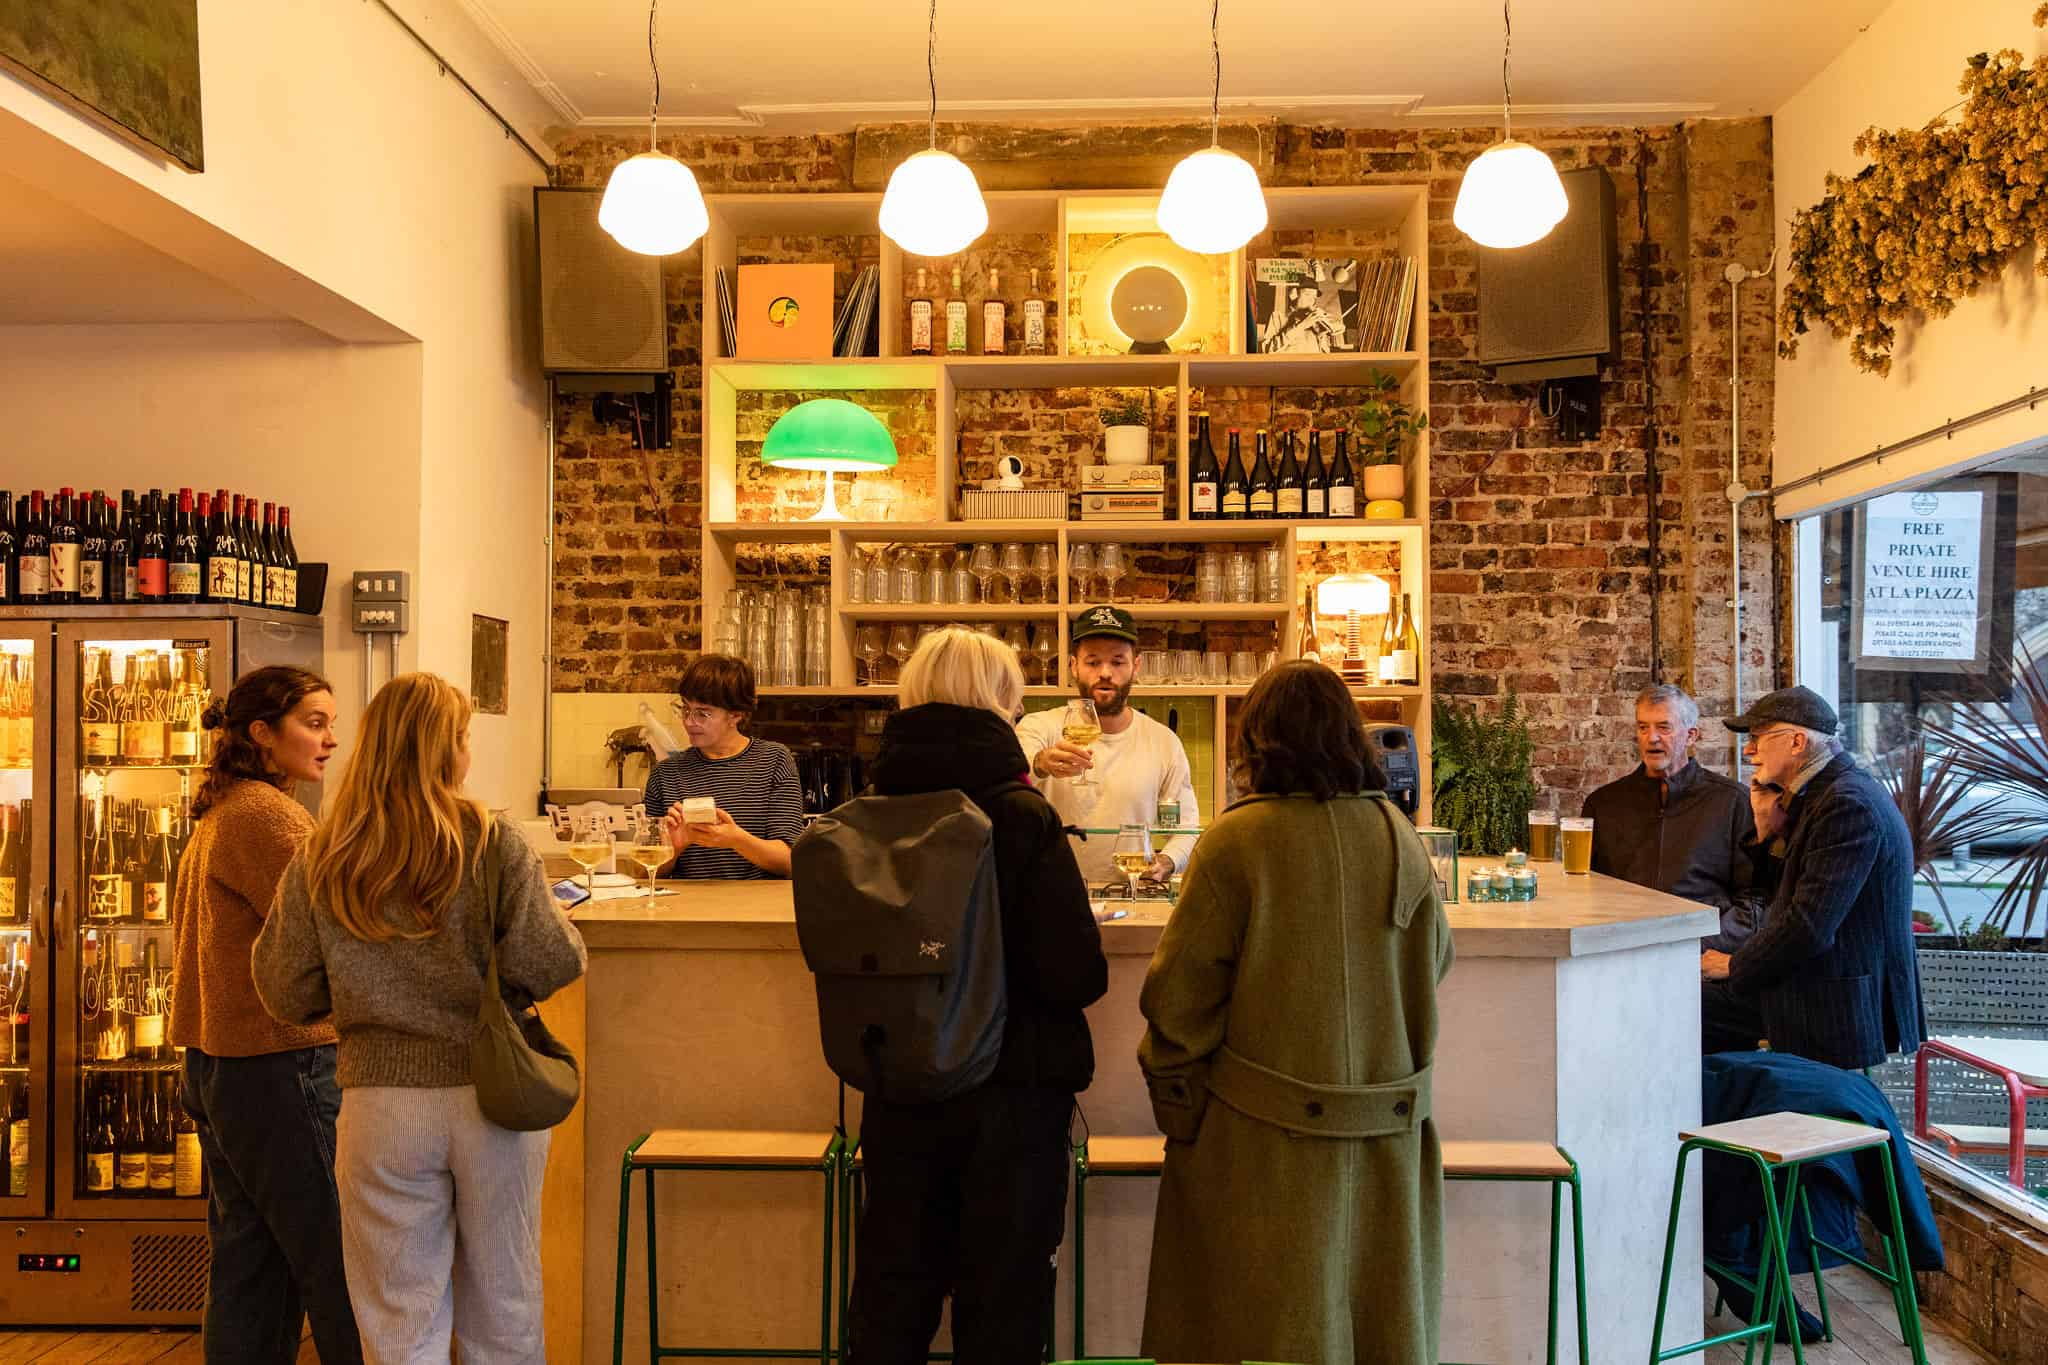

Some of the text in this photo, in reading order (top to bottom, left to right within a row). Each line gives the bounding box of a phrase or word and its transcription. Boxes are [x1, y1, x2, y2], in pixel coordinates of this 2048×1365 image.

[1903, 522, 1945, 536] FREE
[1889, 543, 1957, 557] PRIVATE
[1872, 564, 1972, 579] VENUE HIRE
[1867, 587, 1975, 600] AT LA PIAZZA
